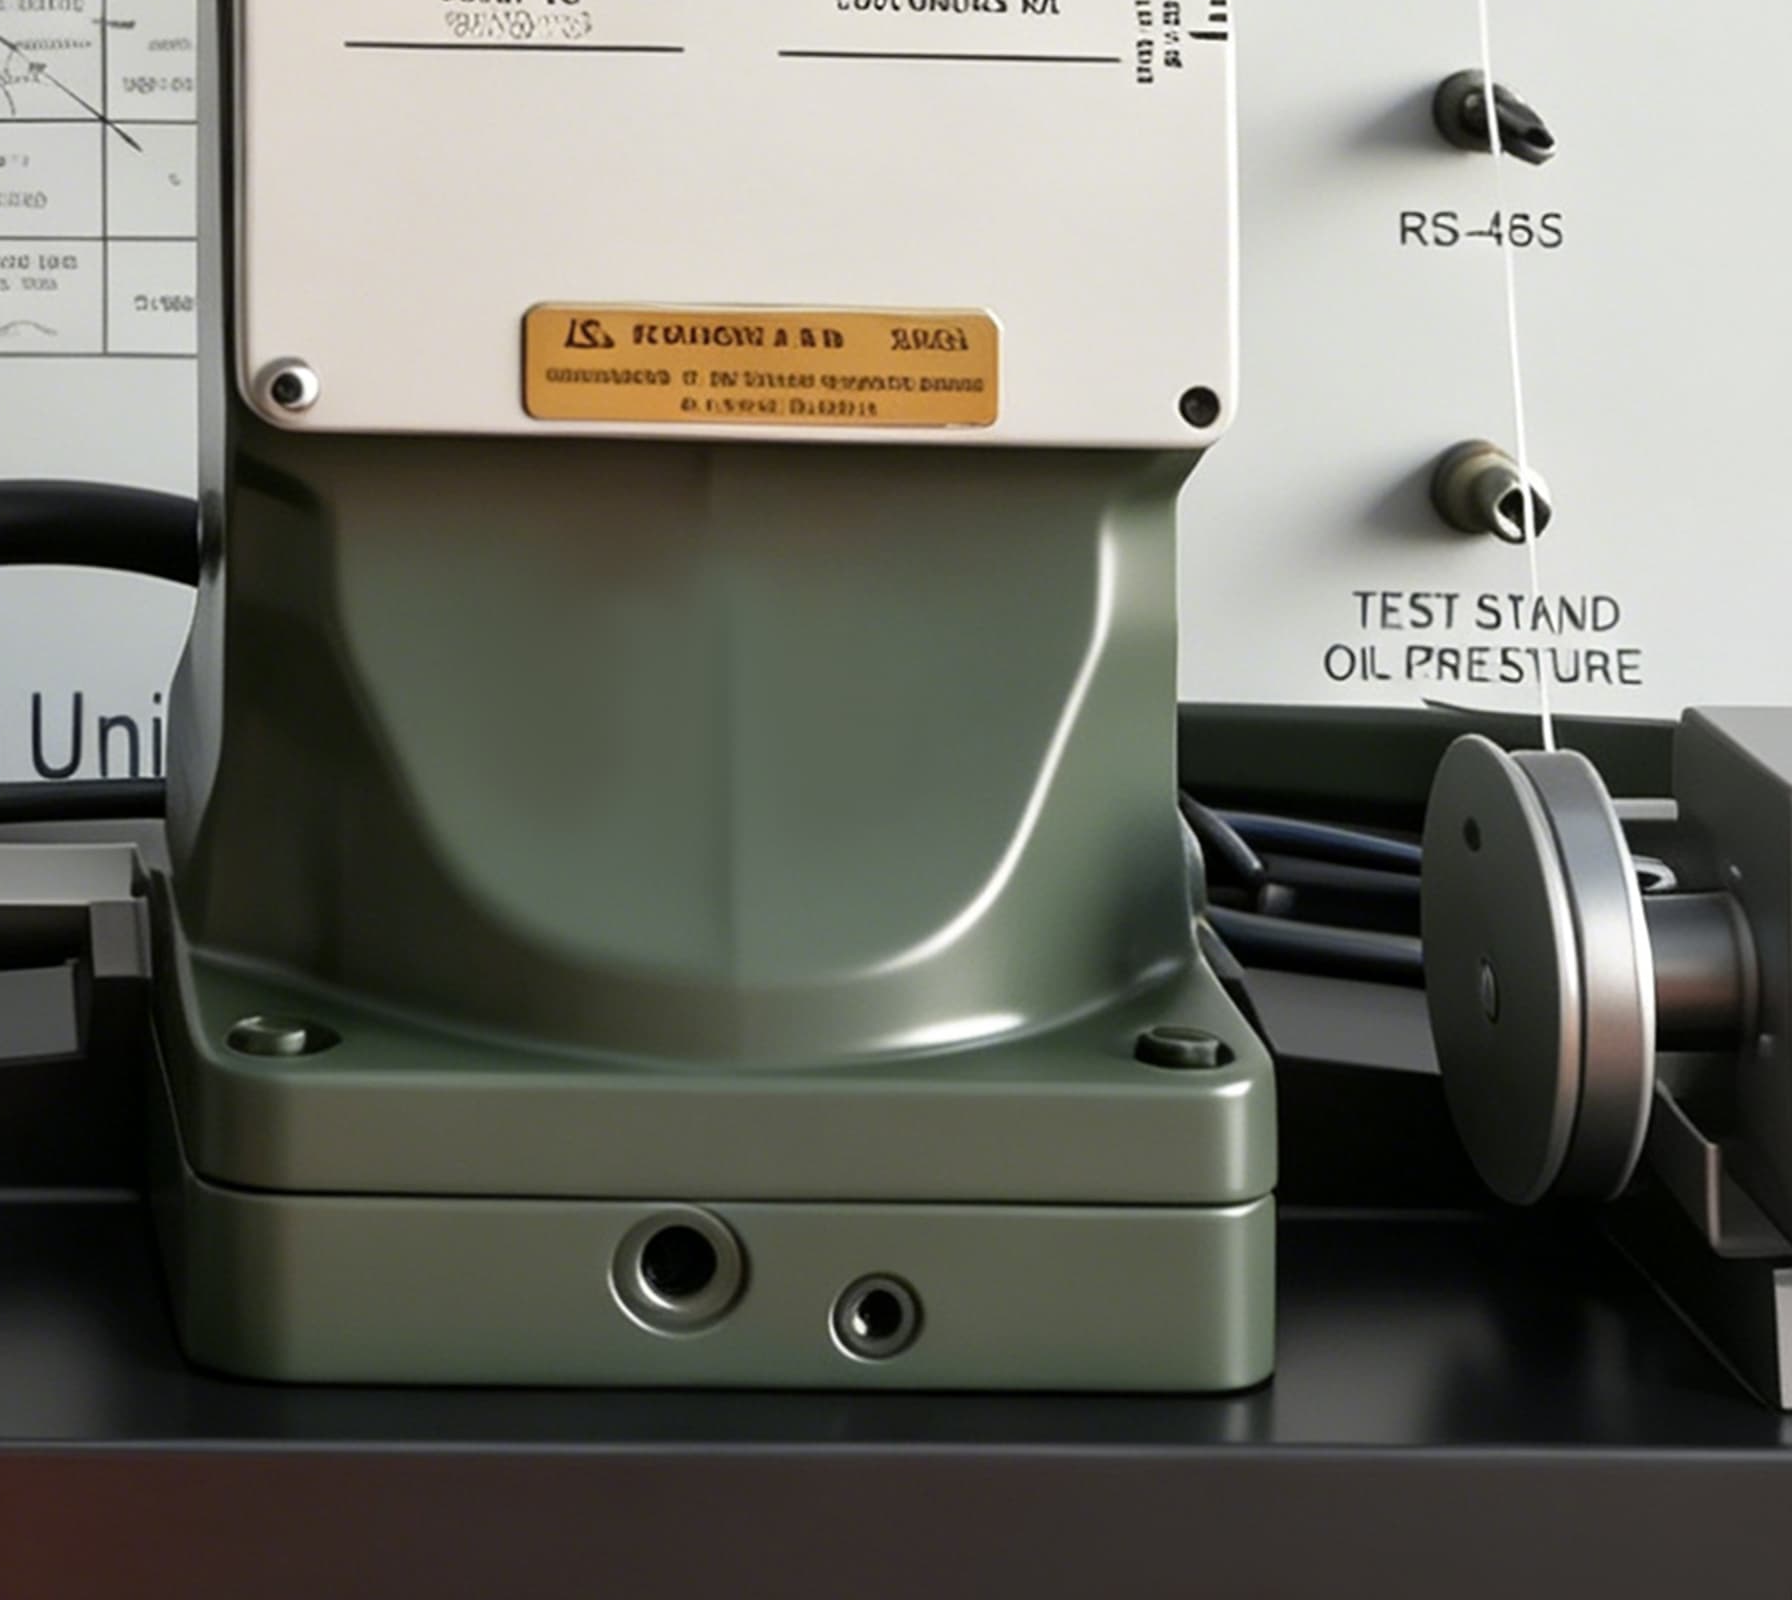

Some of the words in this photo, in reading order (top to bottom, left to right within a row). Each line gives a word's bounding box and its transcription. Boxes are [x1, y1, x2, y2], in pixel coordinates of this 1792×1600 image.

[1351, 590, 1460, 630] TEST
[1475, 593, 1620, 634] STAND
[1323, 643, 1392, 682] OIL
[30, 691, 164, 780] Uni
